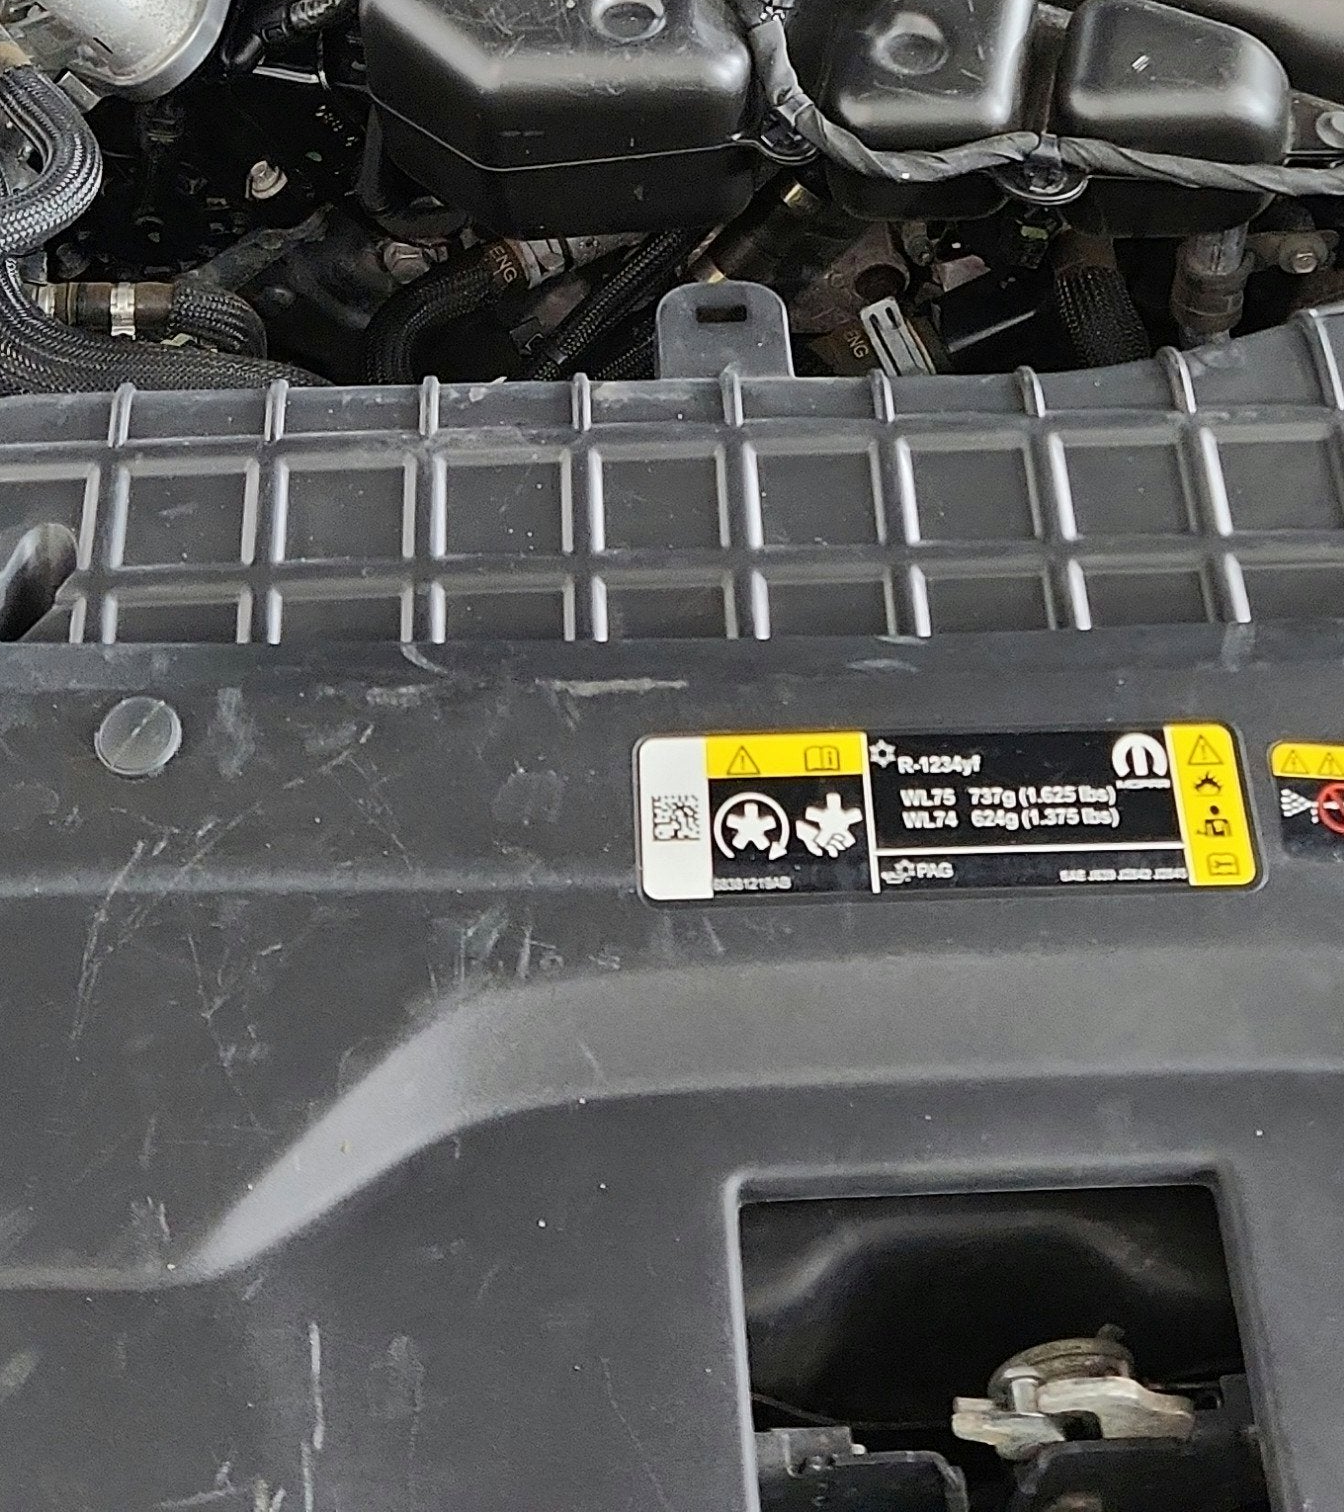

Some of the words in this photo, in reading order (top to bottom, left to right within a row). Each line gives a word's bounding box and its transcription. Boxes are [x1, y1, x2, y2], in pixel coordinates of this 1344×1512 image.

[897, 754, 981, 777] R-1234yf
[899, 788, 956, 807] WL75
[968, 787, 1017, 808] 737g
[1018, 785, 1077, 806] (1.625
[1078, 784, 1117, 806] lbs)
[902, 810, 959, 829] WL74
[971, 809, 1019, 830] 624g
[1021, 808, 1080, 829] (1.375
[1081, 807, 1120, 828] lbs)
[916, 862, 954, 879] PAG
